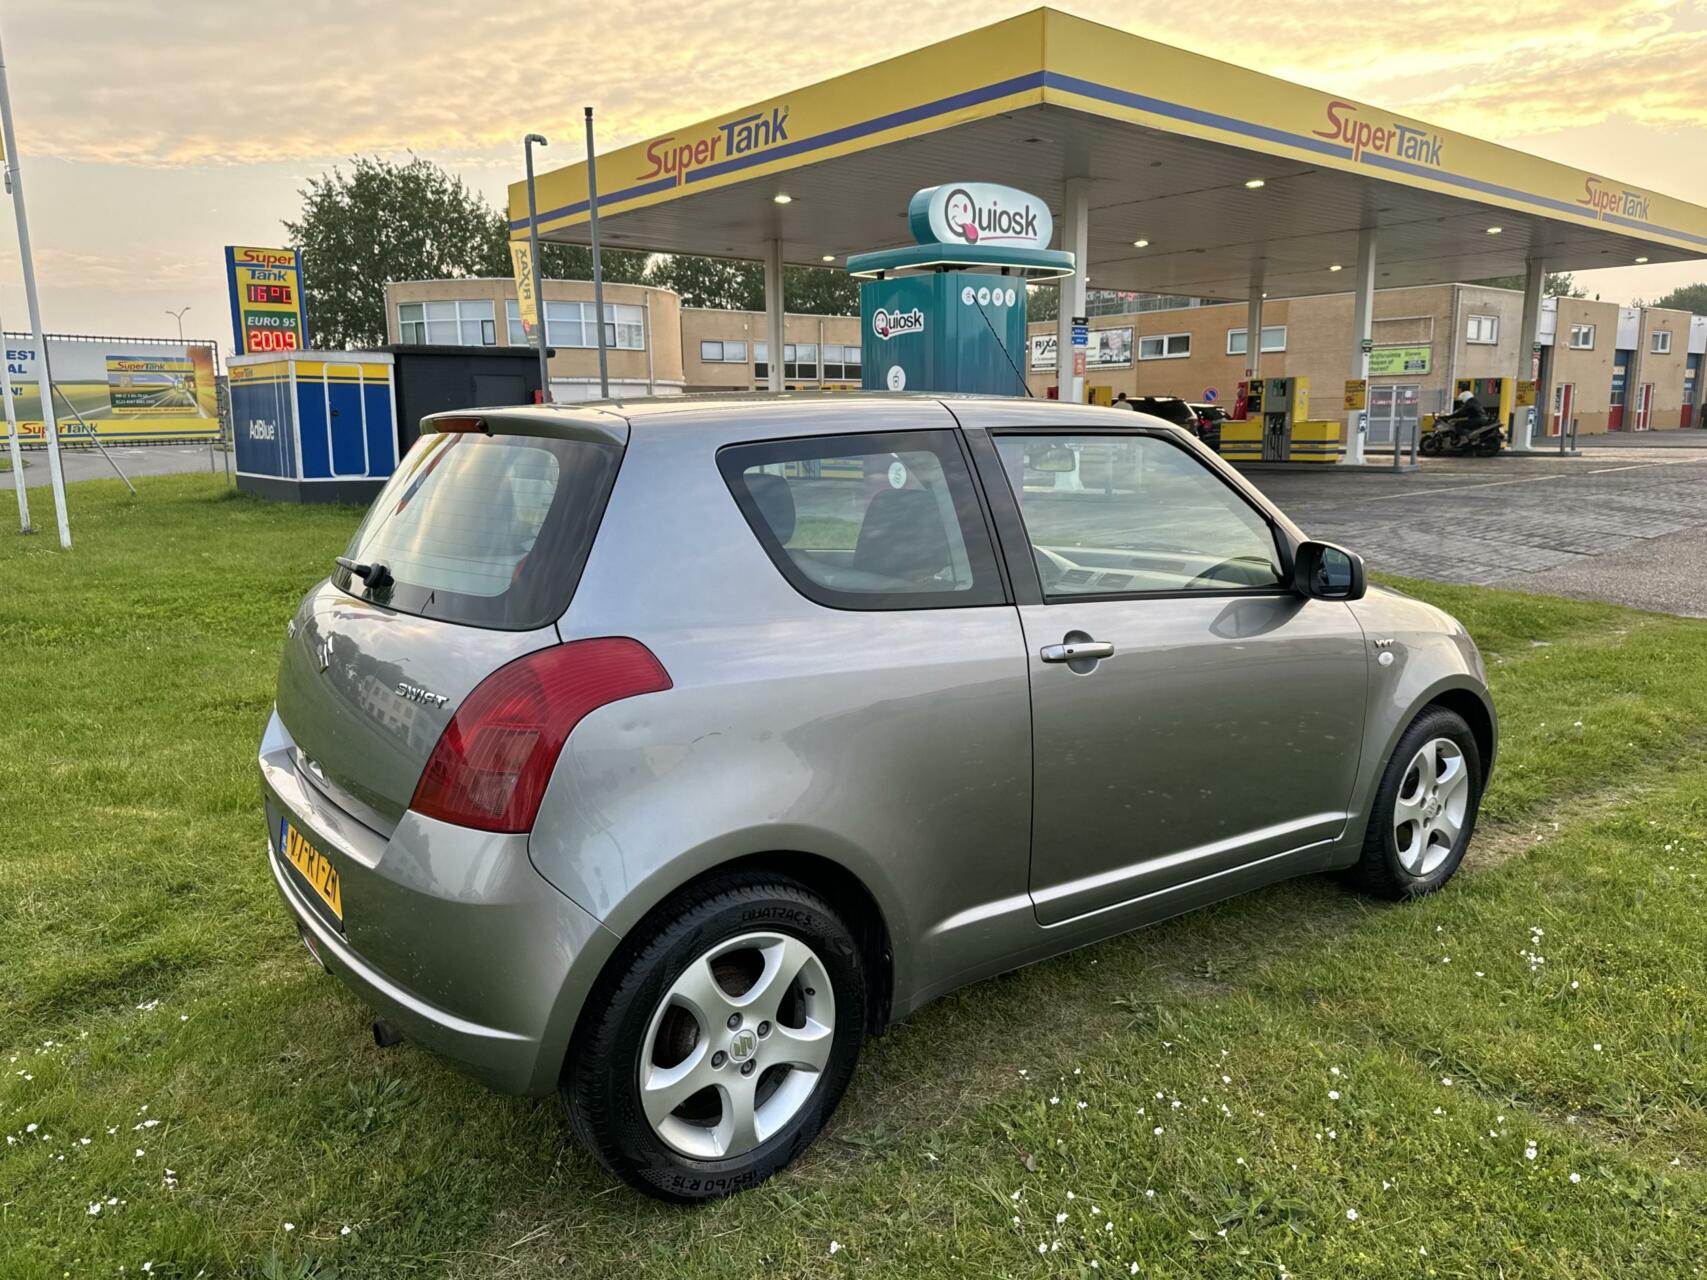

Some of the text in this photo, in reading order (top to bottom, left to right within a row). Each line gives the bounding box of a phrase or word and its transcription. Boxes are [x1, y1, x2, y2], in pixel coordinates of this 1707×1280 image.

[635, 107, 789, 186] SuperTank
[1312, 101, 1442, 166] SuperTank
[1576, 176, 1649, 220] SuperTank
[945, 189, 1037, 244] Quiosk
[236, 249, 294, 269] Super
[246, 269, 287, 281] Tank
[248, 316, 296, 327] EURO 95
[875, 310, 923, 337] Quiosk
[17, 422, 97, 439] SuprTank
[395, 682, 449, 709] SWIFT
